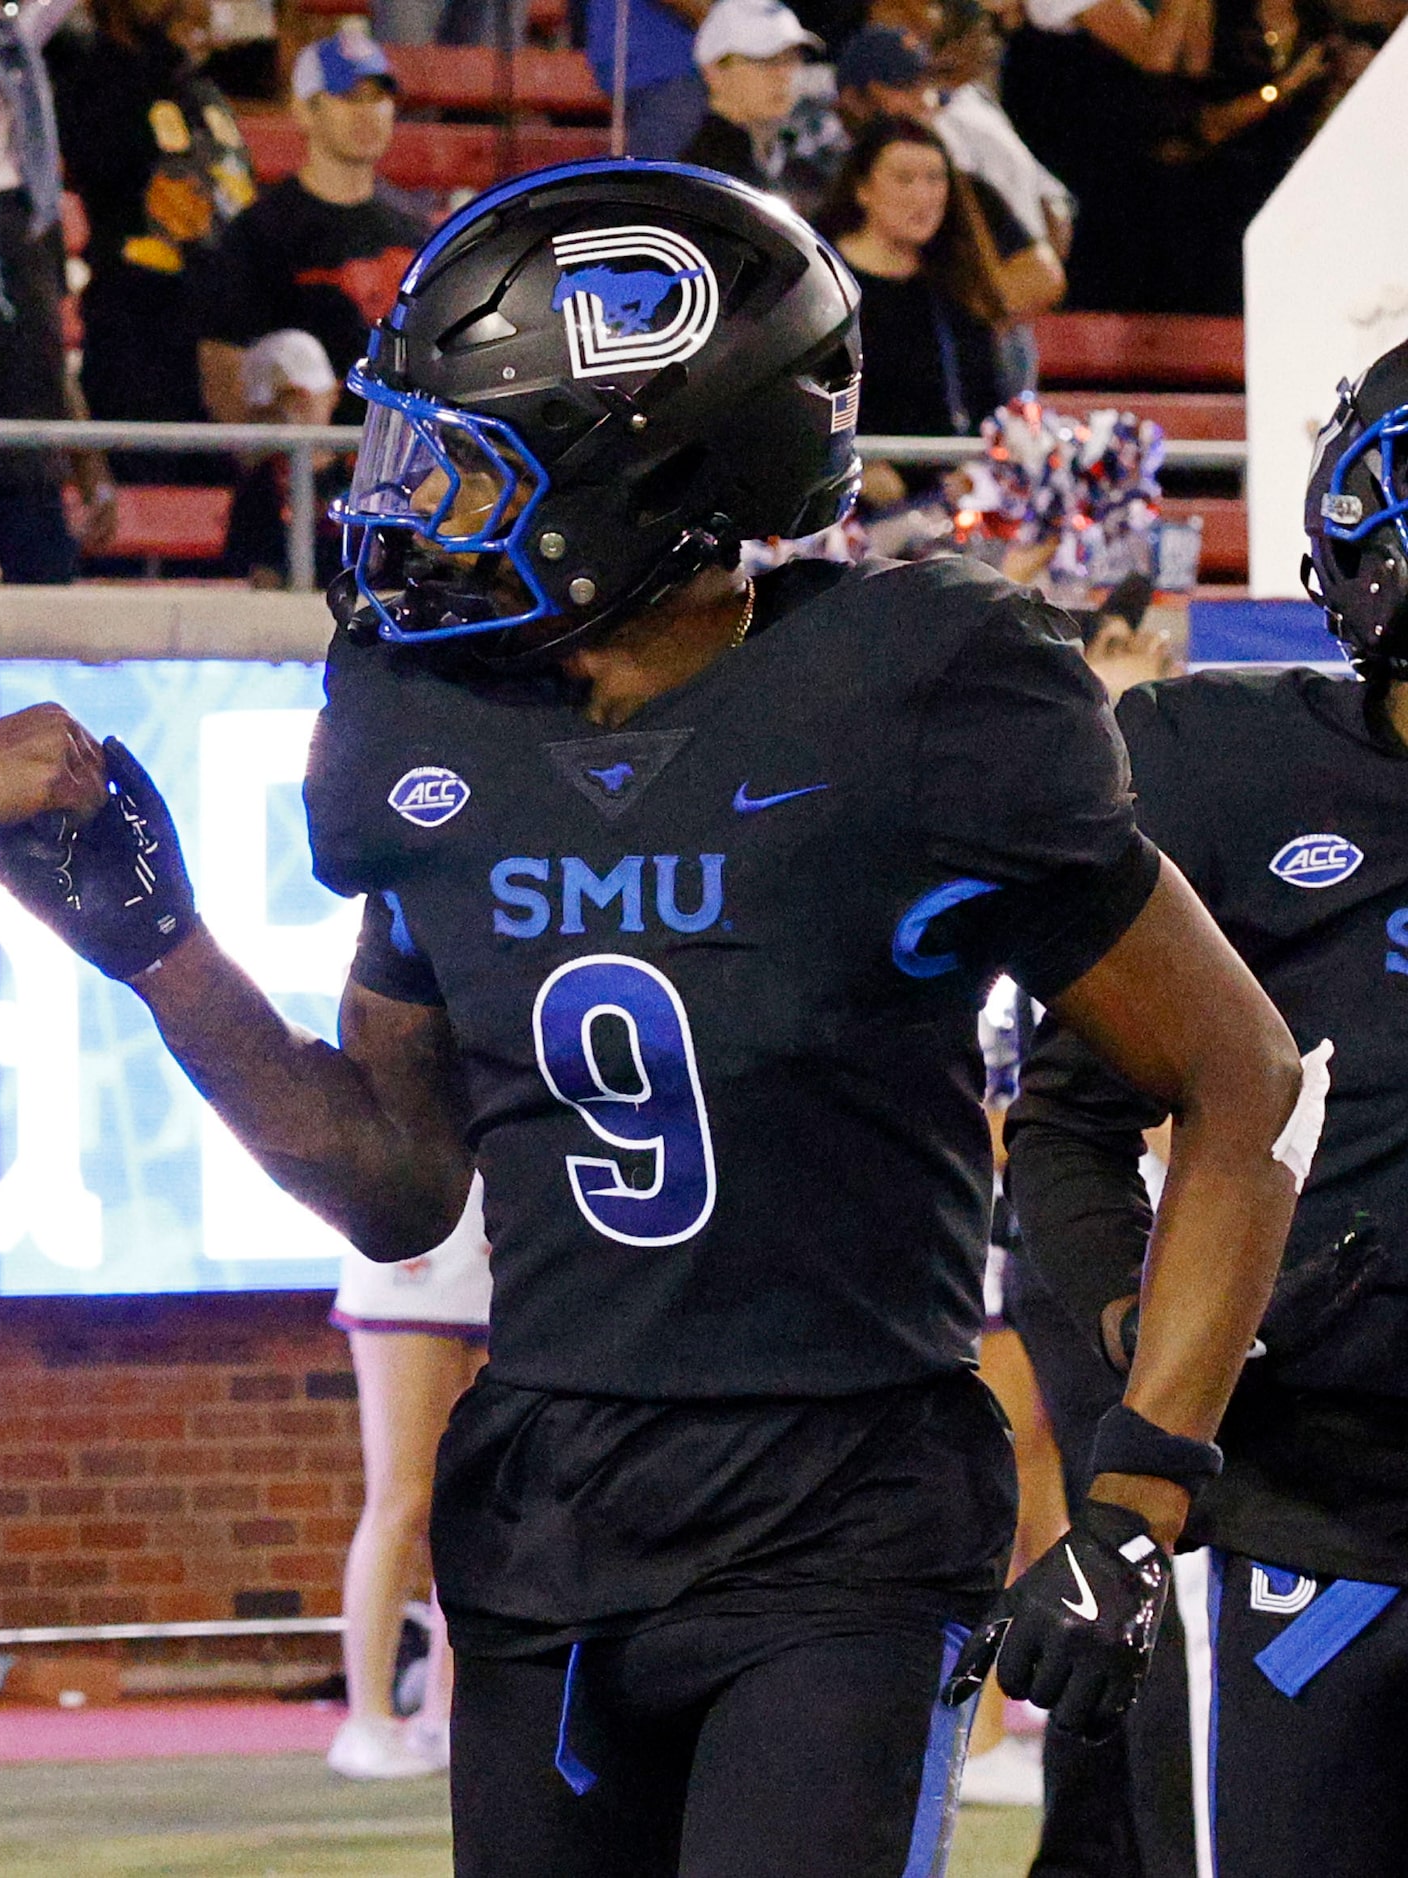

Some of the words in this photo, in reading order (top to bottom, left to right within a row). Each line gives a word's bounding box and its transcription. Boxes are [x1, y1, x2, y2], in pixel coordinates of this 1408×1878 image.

[401, 779, 457, 805] ACC
[1283, 843, 1350, 871] ACC
[489, 853, 727, 939] SMU
[532, 953, 718, 1248] 9
